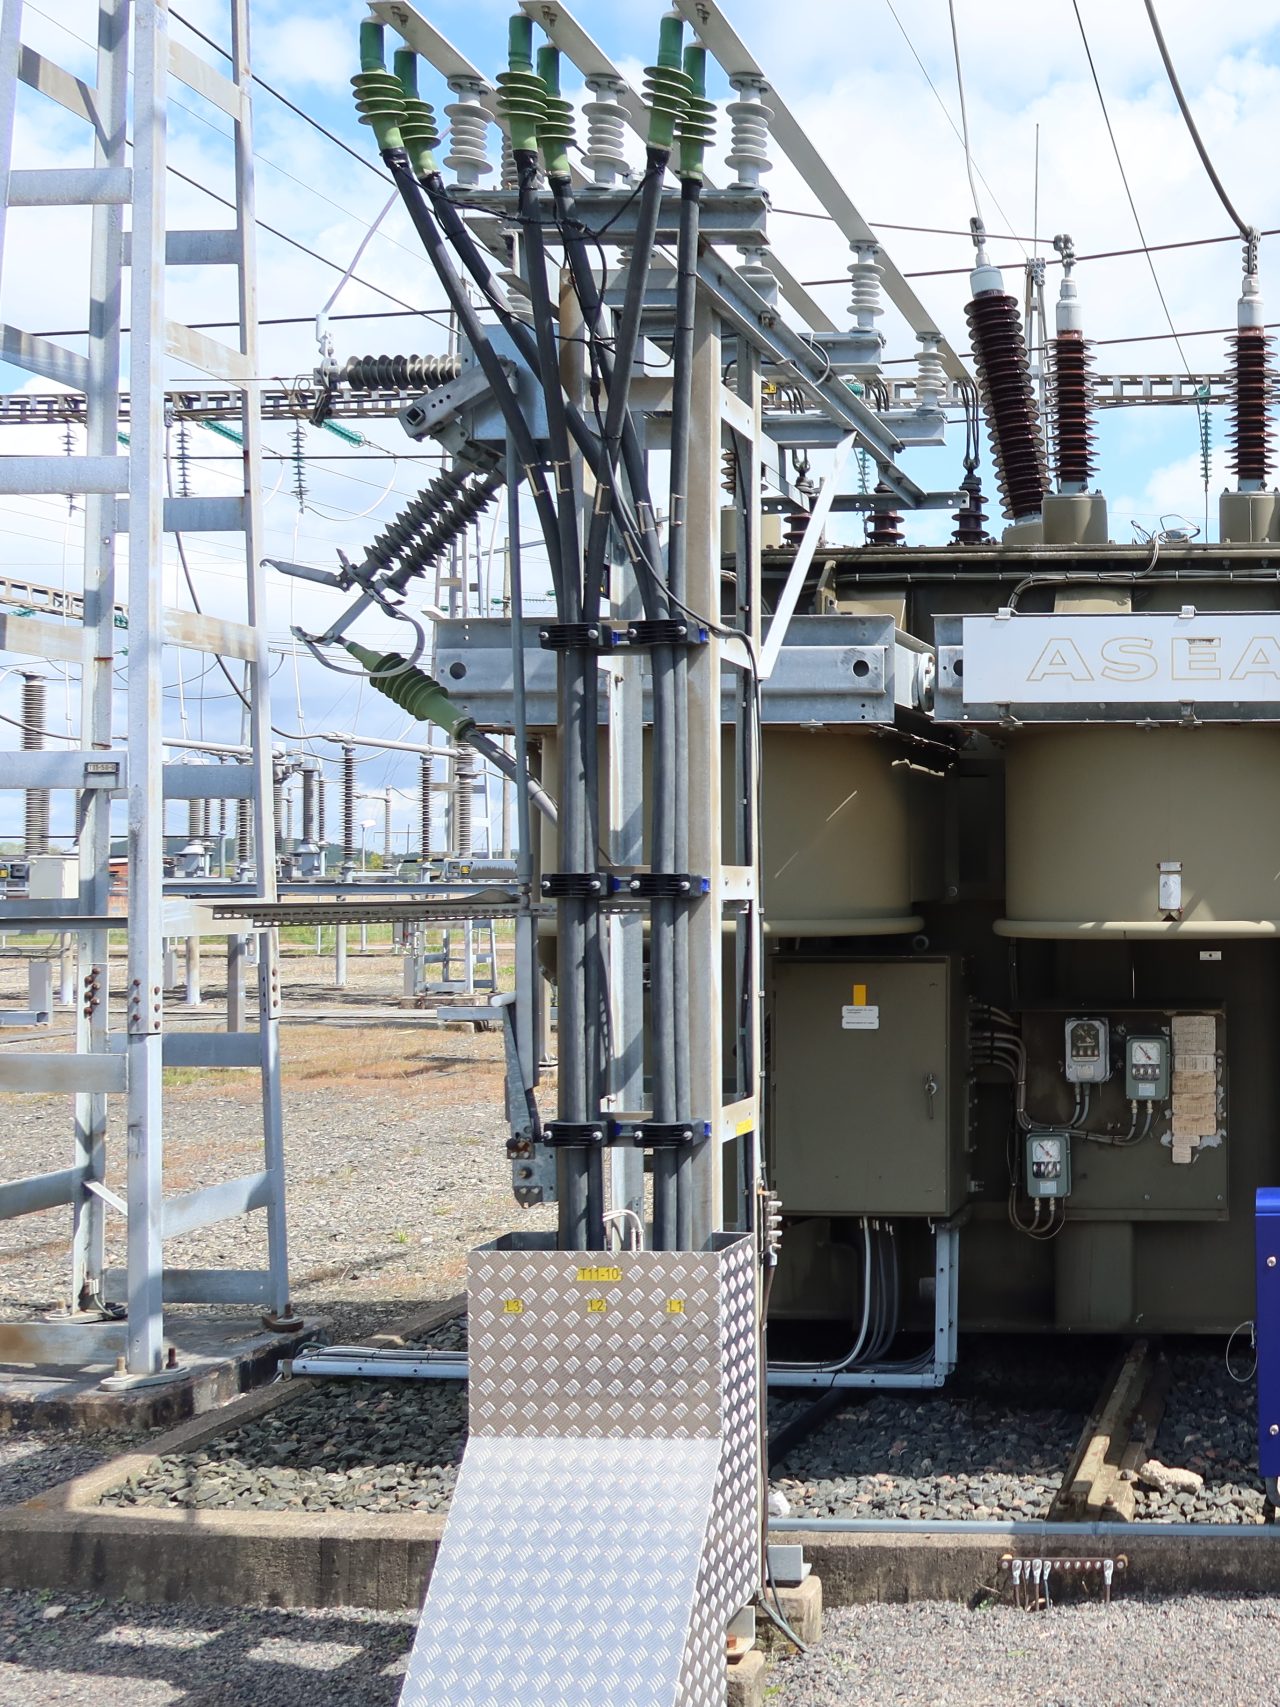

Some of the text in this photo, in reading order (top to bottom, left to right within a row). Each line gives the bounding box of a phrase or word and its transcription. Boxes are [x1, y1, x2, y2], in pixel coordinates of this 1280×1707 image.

[580, 1268, 619, 1280] T11-10
[506, 1300, 682, 1312] L3 L2 L1
